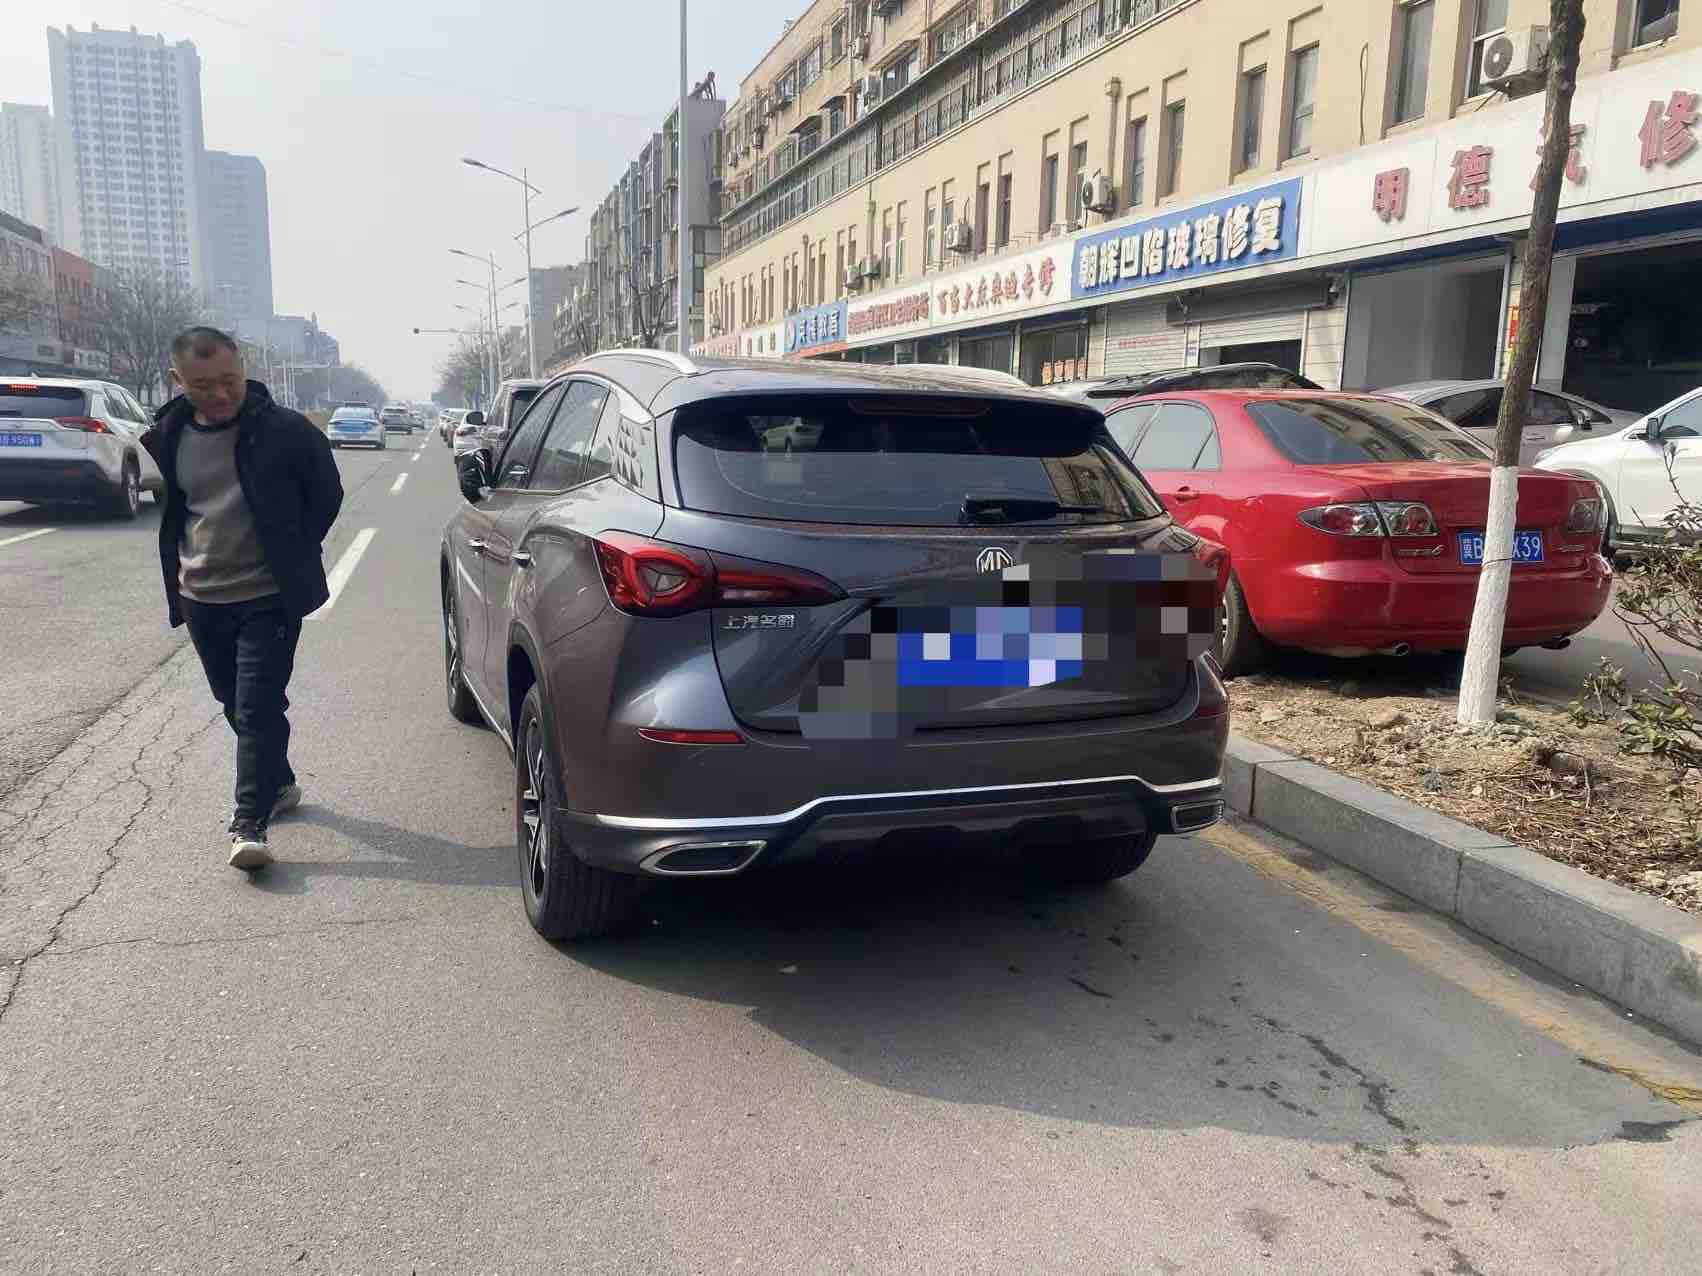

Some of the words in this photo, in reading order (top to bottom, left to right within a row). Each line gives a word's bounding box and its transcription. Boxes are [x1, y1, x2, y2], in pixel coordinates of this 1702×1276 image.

[1080, 197, 1283, 288] 朝辉凹陷玻璃修复
[720, 614, 795, 632] 上汽名爵
